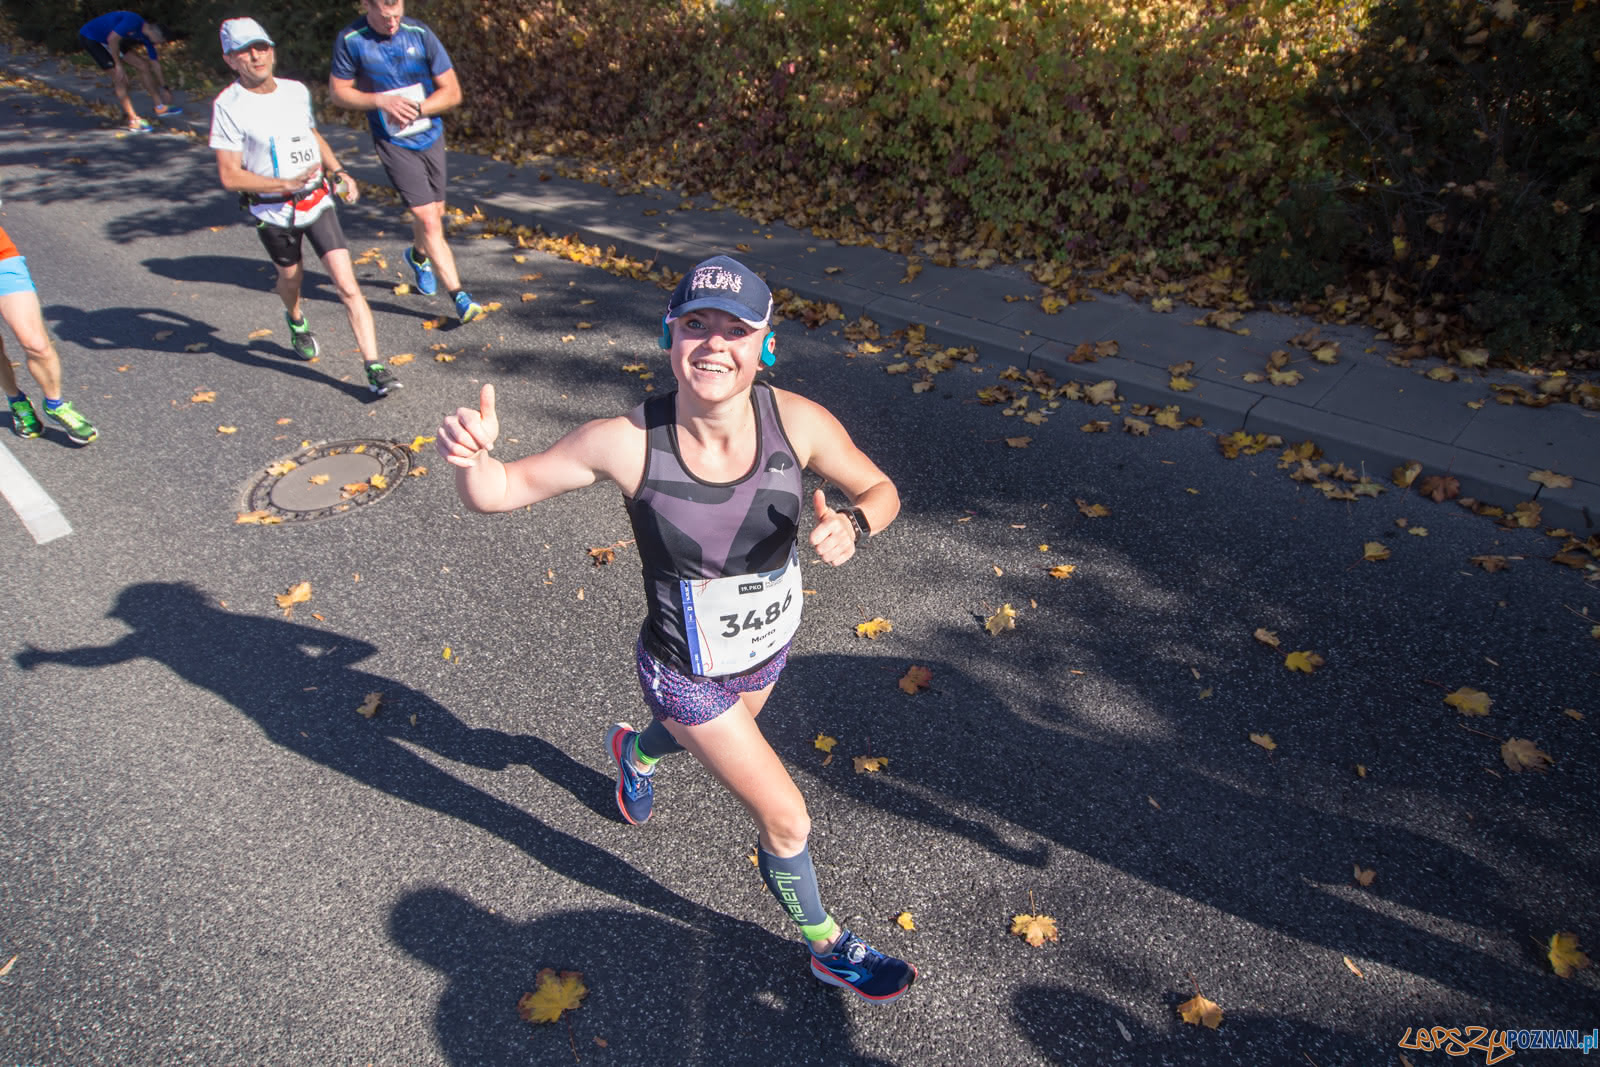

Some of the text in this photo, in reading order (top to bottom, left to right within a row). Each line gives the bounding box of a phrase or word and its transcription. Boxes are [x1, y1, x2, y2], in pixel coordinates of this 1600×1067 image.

[290, 148, 314, 164] 5161
[719, 588, 792, 638] 3486
[751, 628, 776, 644] Marta
